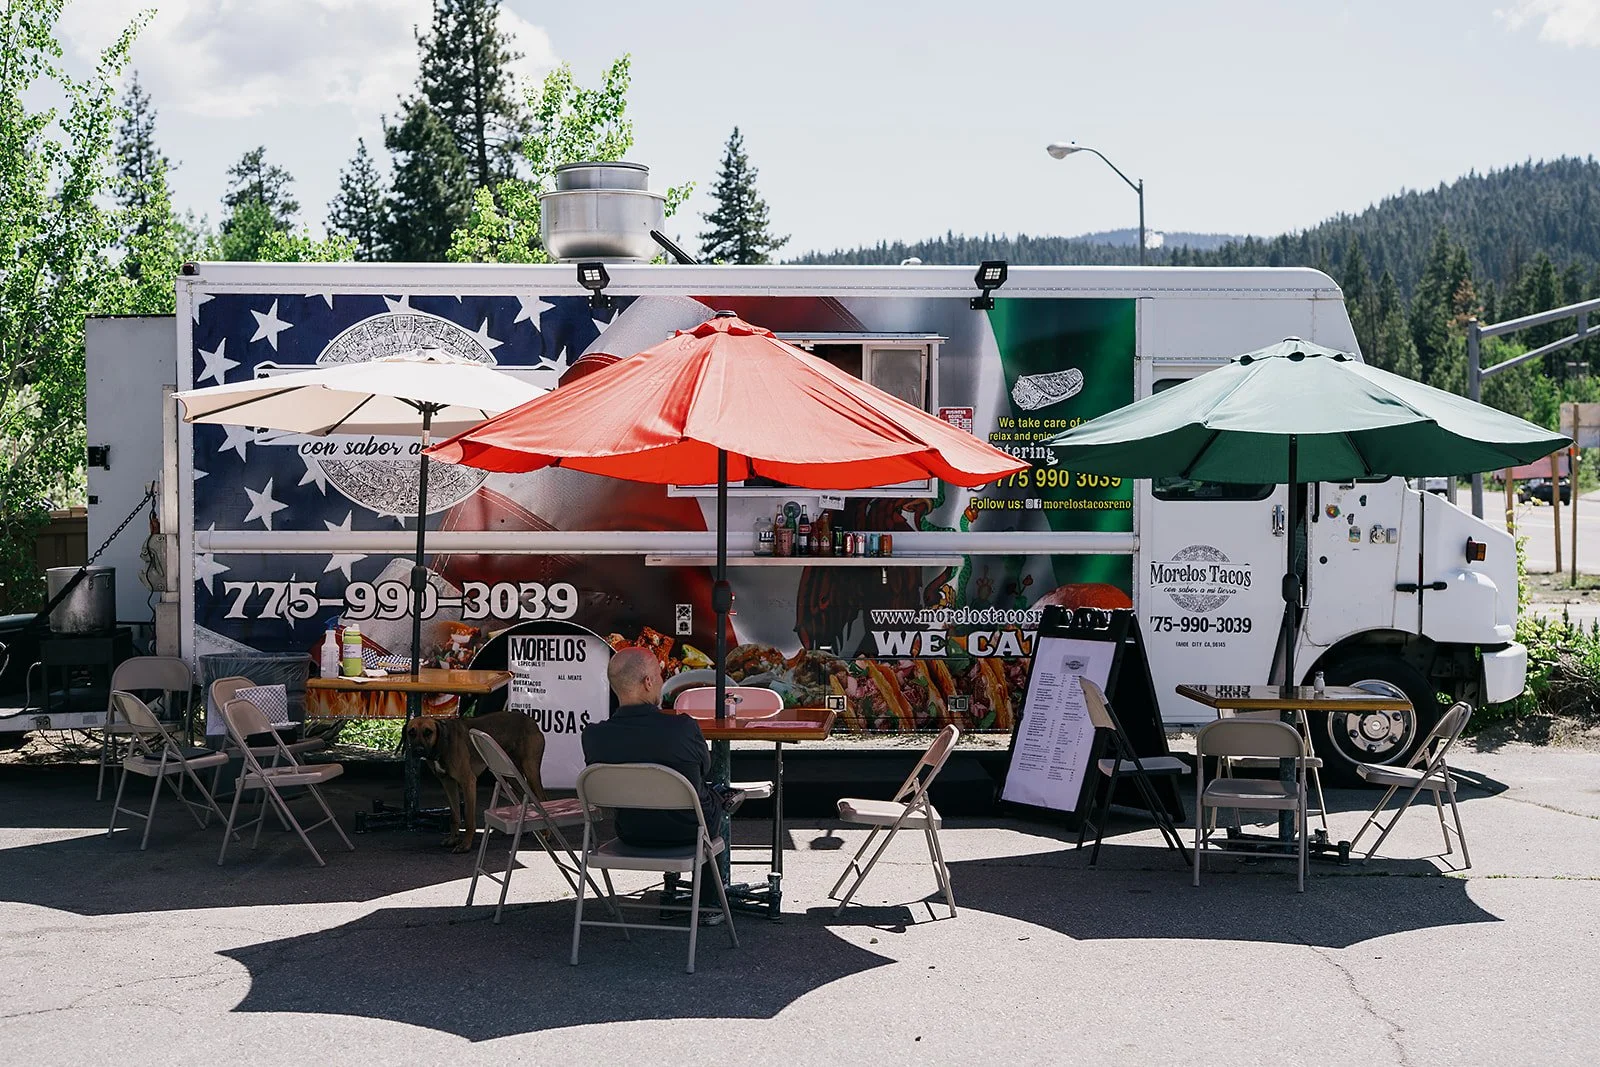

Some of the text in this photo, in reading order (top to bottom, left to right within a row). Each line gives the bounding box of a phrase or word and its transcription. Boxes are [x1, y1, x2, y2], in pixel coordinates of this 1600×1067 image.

[999, 417, 1015, 428] We
[1018, 417, 1041, 428] take
[1043, 419, 1067, 428] care
[1070, 417, 1081, 428] of
[301, 435, 421, 456] con sabor a
[989, 432, 1057, 442] relax and enjo
[992, 442, 1059, 466] tering
[1035, 469, 1069, 487] 990
[1076, 472, 1121, 487] 3039
[970, 499, 1005, 510] Follow
[1007, 500, 1024, 509] us:
[1043, 499, 1131, 510] morelostacosreno
[1150, 564, 1252, 587] Morelos Tacos
[1178, 585, 1198, 593] sabor
[1217, 586, 1237, 594] tierra
[223, 580, 579, 620] 775-990-3039
[870, 606, 1060, 625] www.morelostacosr
[511, 637, 587, 663] MORELOS
[871, 630, 949, 657] WE
